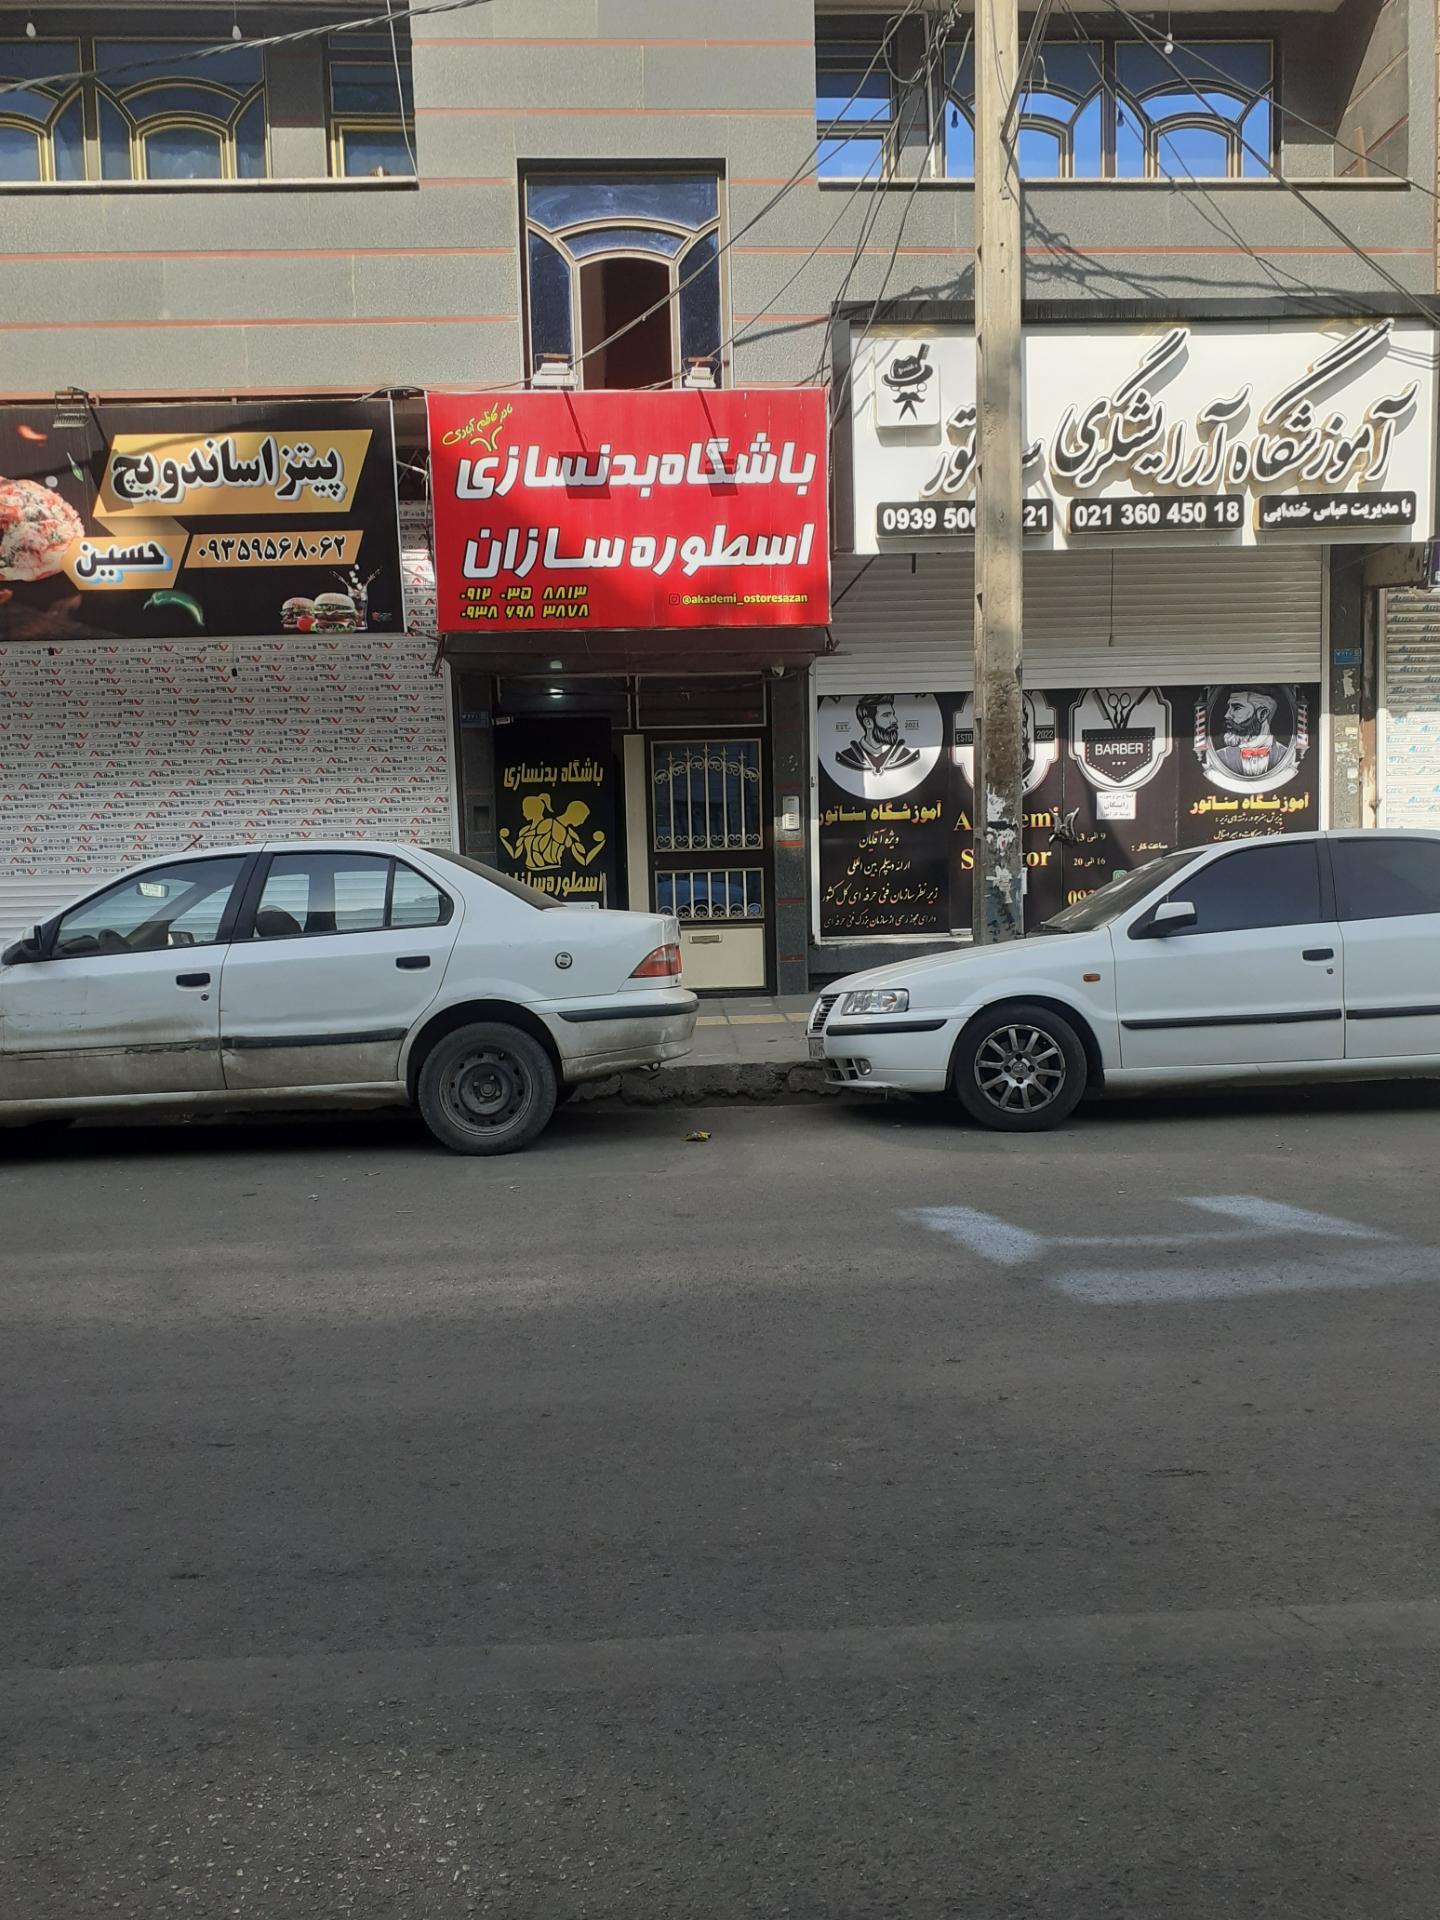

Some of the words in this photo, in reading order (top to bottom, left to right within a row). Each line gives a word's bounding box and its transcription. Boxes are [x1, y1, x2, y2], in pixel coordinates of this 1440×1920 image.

[1051, 329, 1253, 487] آرایشگری
[1229, 319, 1421, 484] آموزشگاه
[455, 443, 658, 499] بدنسازی
[658, 432, 817, 496] باشگاه
[883, 508, 936, 530] 0939
[1074, 504, 1112, 526] 021
[1121, 504, 1160, 525] 360
[1167, 503, 1207, 523] 450
[1214, 501, 1239, 522] 18
[1263, 502, 1311, 522] خندابی
[1313, 502, 1348, 520] عباس
[1350, 503, 1398, 519] مدیریت
[1401, 499, 1412, 518] با
[75, 541, 171, 580] حسین
[463, 527, 626, 578] سازان
[628, 521, 815, 577] اسطوره
[682, 593, 808, 605] @akademi_ostoresazan
[1036, 730, 1054, 739] 2022
[1095, 743, 1143, 755] BARBER
[504, 761, 557, 791] بدنسازی
[561, 758, 603, 786] باشگاه
[871, 800, 942, 823] آموزشگاه
[1189, 795, 1239, 814] سناتور
[1241, 792, 1309, 812] آموزشگاه
[859, 828, 887, 851] آقایان
[884, 829, 900, 849] ویژه
[1073, 858, 1083, 866] 20
[547, 871, 603, 896] اسطوره
